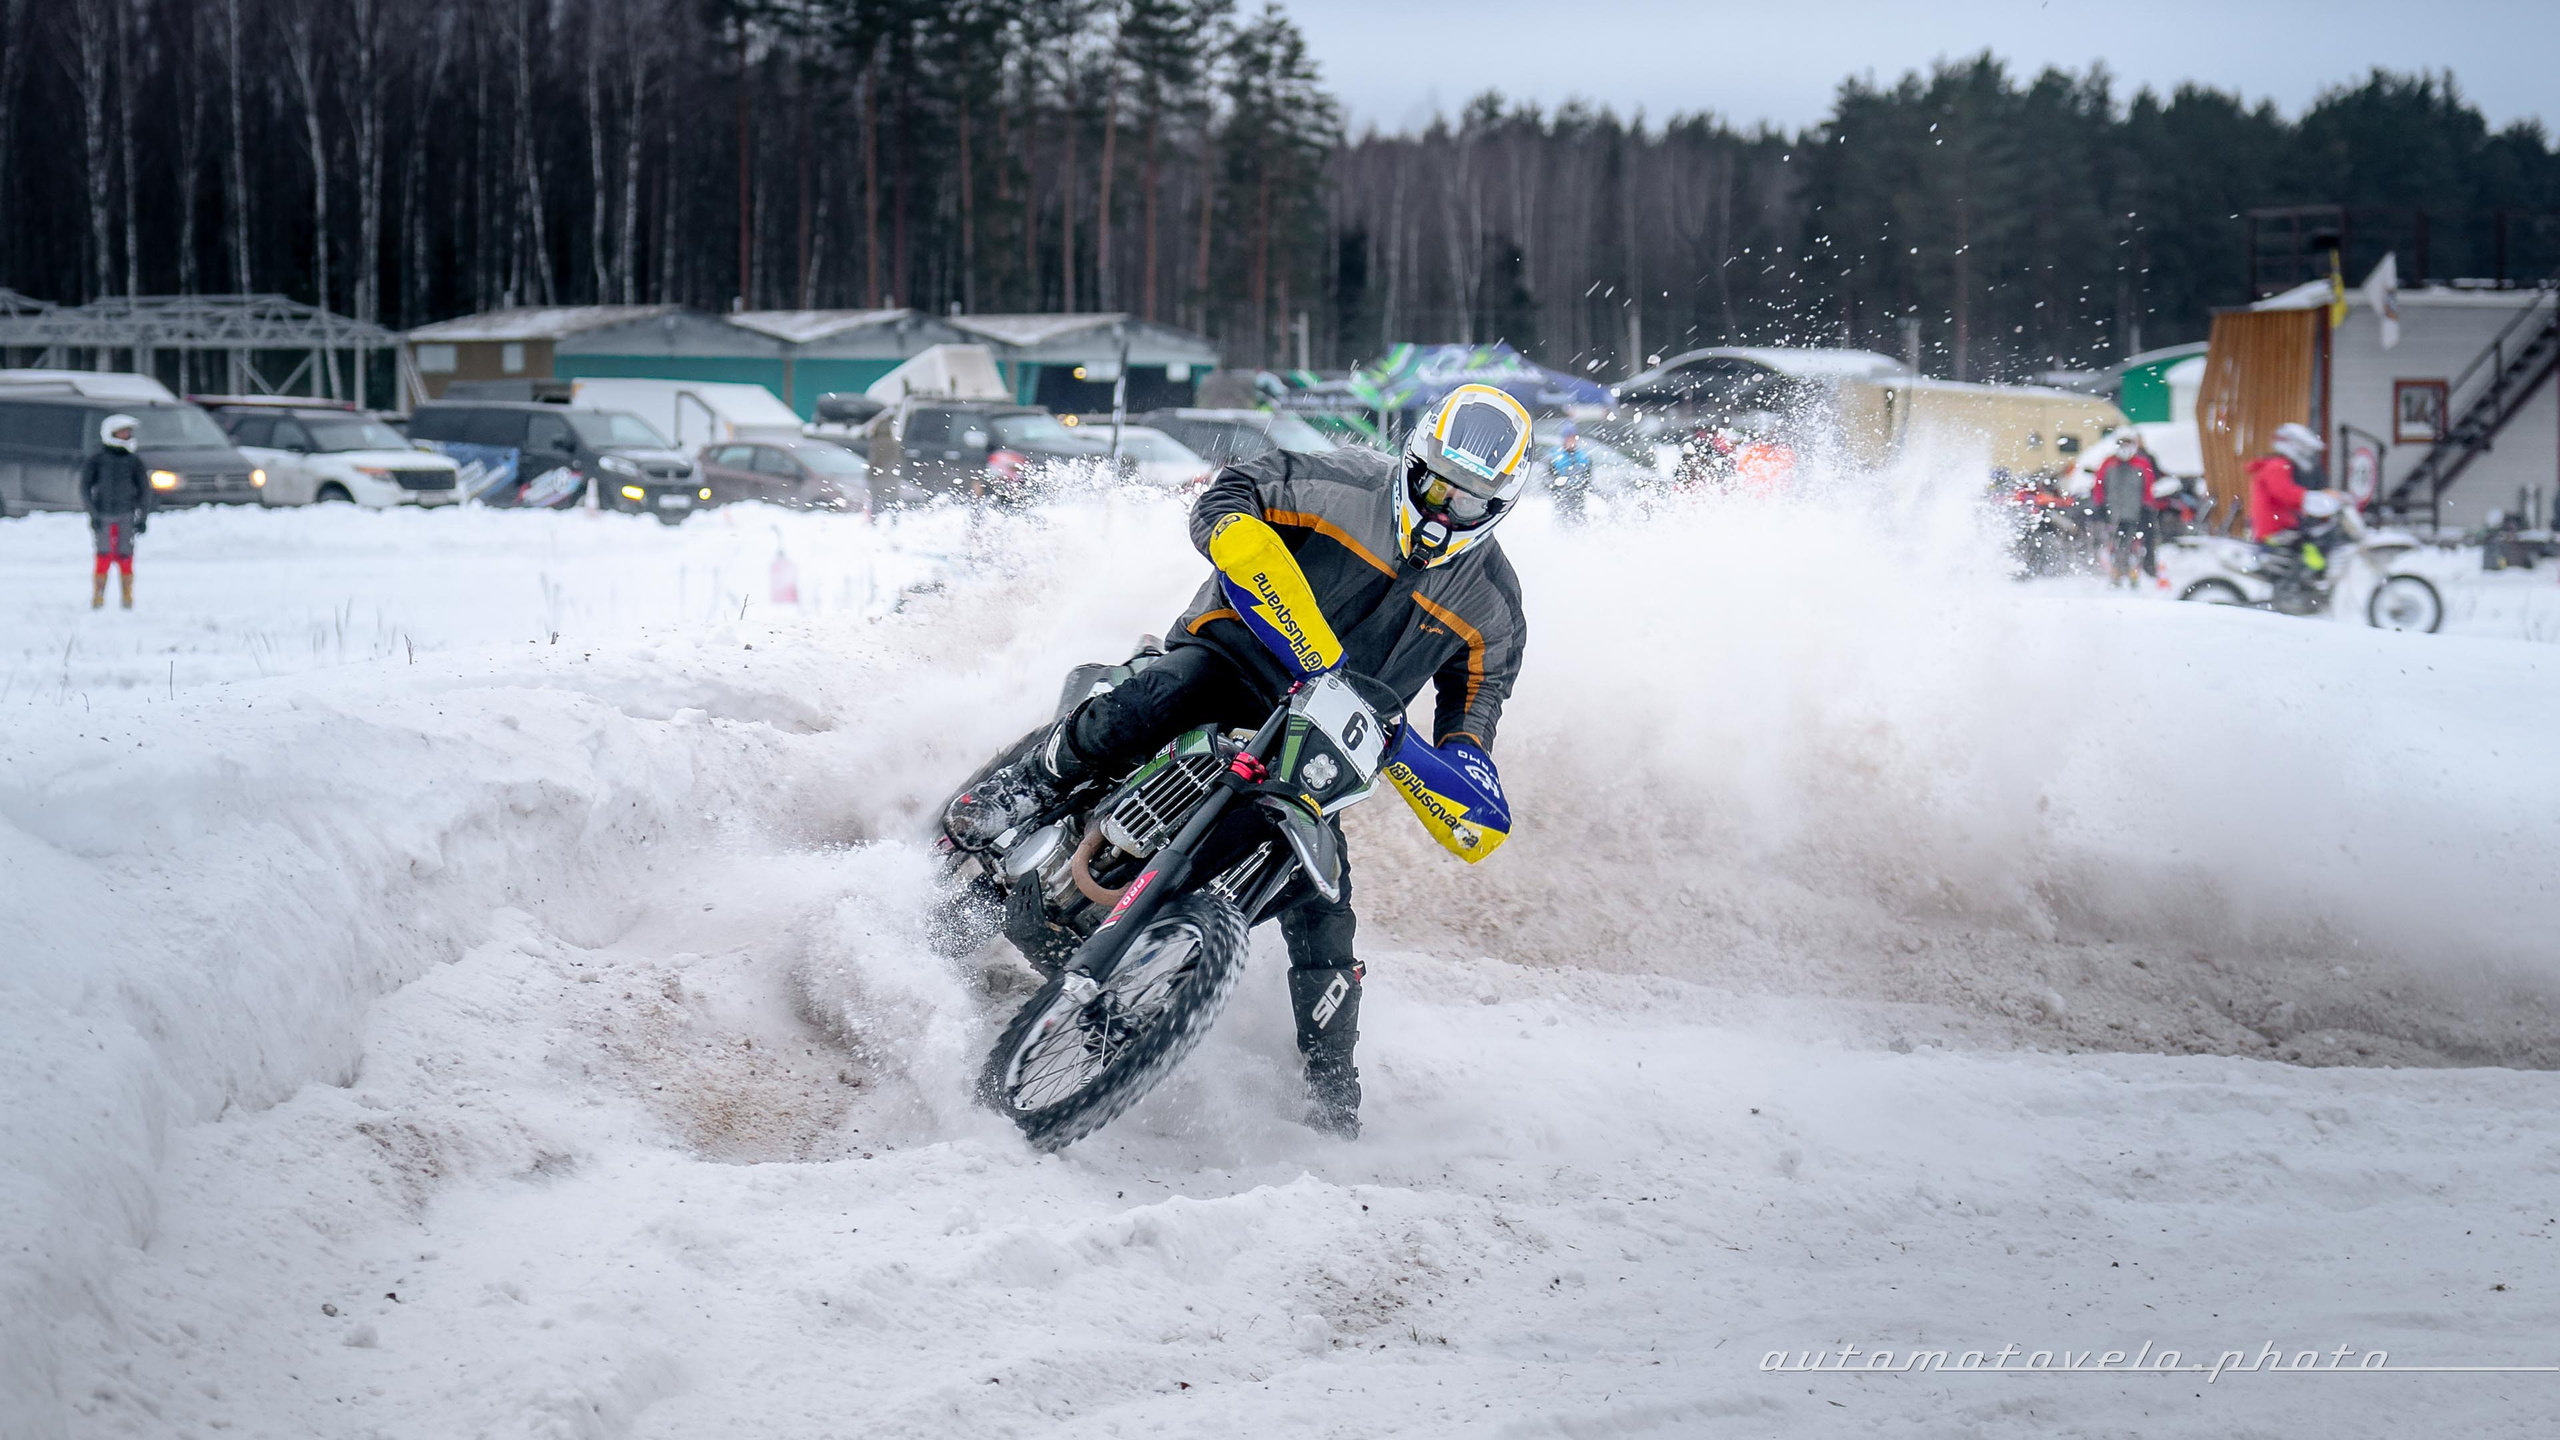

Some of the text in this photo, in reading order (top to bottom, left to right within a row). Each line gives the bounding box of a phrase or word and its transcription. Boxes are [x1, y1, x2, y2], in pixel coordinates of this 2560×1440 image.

[1252, 572, 1311, 655] Husqvarna
[1341, 711, 1369, 752] 6
[1122, 878, 1145, 906] PRO
[1311, 971, 1350, 1030] SIDI
